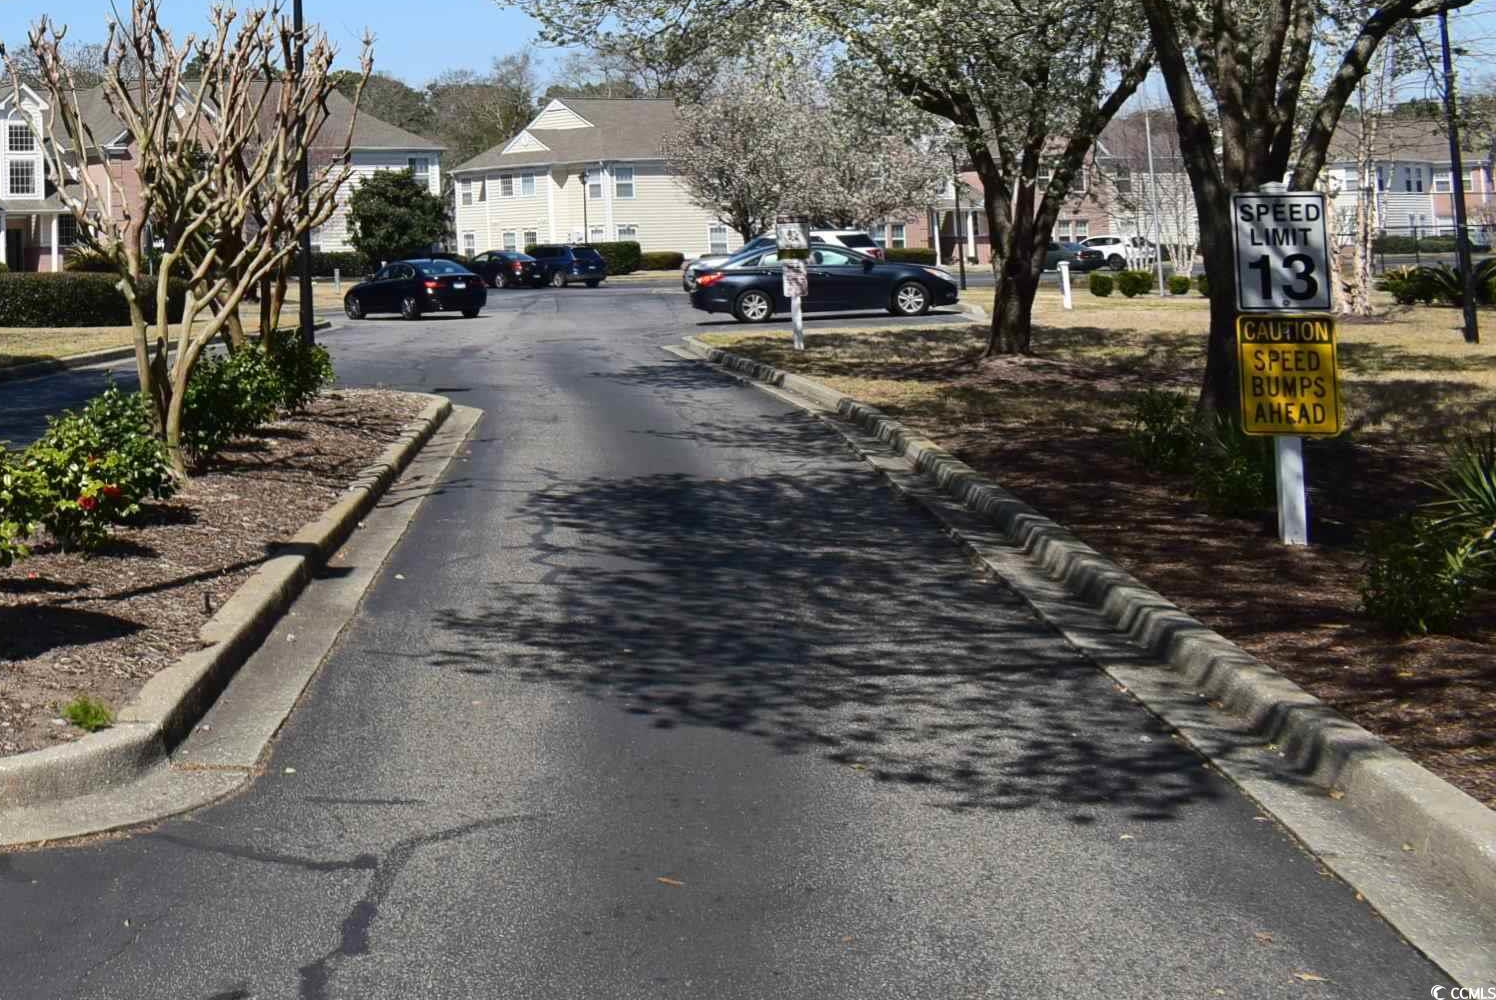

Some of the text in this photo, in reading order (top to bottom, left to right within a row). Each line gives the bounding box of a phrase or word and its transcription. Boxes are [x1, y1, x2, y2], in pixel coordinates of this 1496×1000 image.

[1240, 203, 1320, 222] SPEED
[1250, 228, 1312, 246] LIMIT
[1249, 253, 1318, 300] 13
[1244, 321, 1328, 341] CAUTION
[1254, 350, 1320, 371] SPEED
[1252, 376, 1326, 398] BUMPS
[1255, 402, 1325, 424] AHEAD
